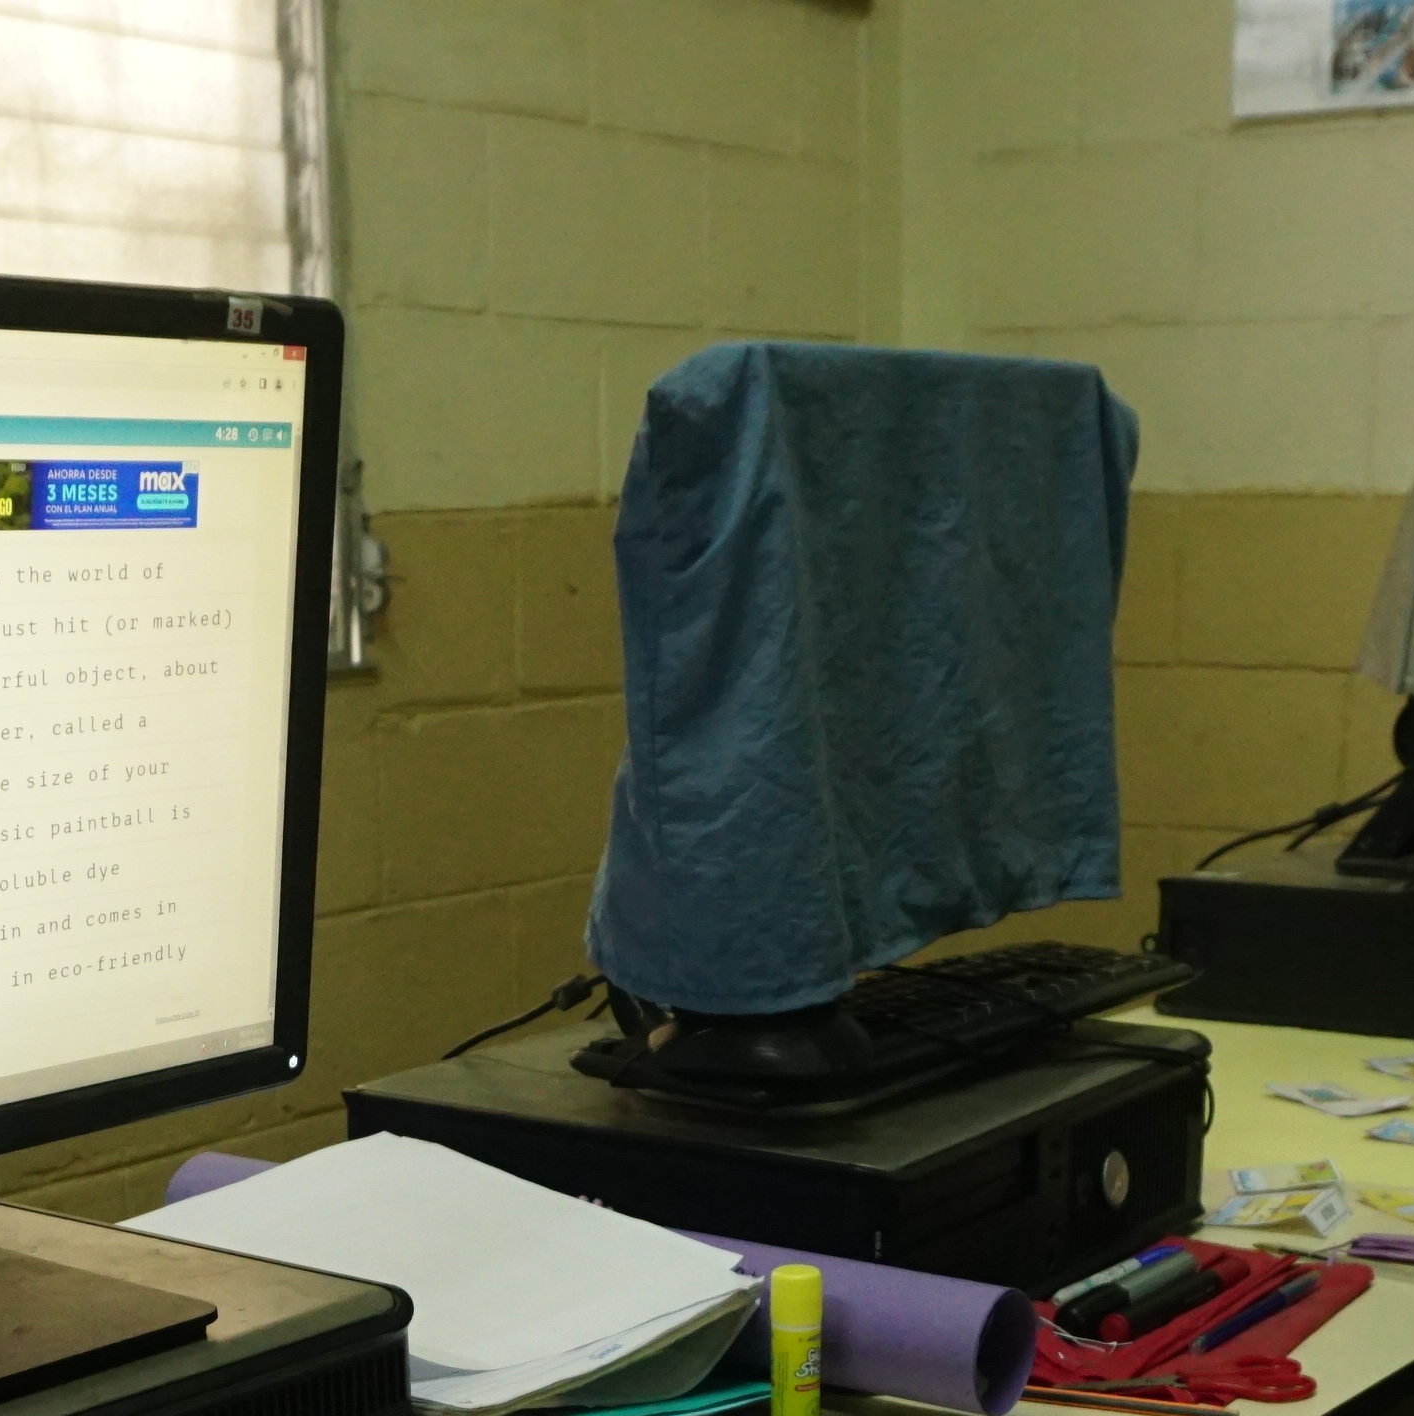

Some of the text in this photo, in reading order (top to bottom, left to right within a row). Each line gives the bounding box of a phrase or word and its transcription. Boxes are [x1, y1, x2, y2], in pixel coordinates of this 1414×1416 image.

[233, 308, 254, 330] 35
[215, 426, 238, 441] 4:28
[47, 469, 117, 480] AHORRA DESDE
[140, 471, 186, 491] max
[47, 484, 118, 501] 3 MESES
[45, 504, 117, 514] CON EL PLAN ANUAL
[16, 565, 53, 585] the
[67, 562, 129, 583] world
[142, 561, 164, 580] of
[53, 616, 89, 635] hit
[104, 614, 139, 637] (or
[152, 608, 232, 631] marked)
[65, 665, 147, 688] object,
[163, 659, 218, 678] about
[51, 712, 124, 737] called
[137, 715, 148, 729] a
[26, 770, 74, 790] size
[88, 763, 110, 783] of
[124, 761, 170, 783] your
[50, 806, 155, 841] paintball
[171, 804, 191, 822] is
[86, 862, 121, 883] dye
[36, 913, 72, 936] and
[85, 906, 142, 928] comes
[156, 899, 177, 917] in
[11, 970, 34, 988] in
[47, 943, 187, 981] eco-friendly
